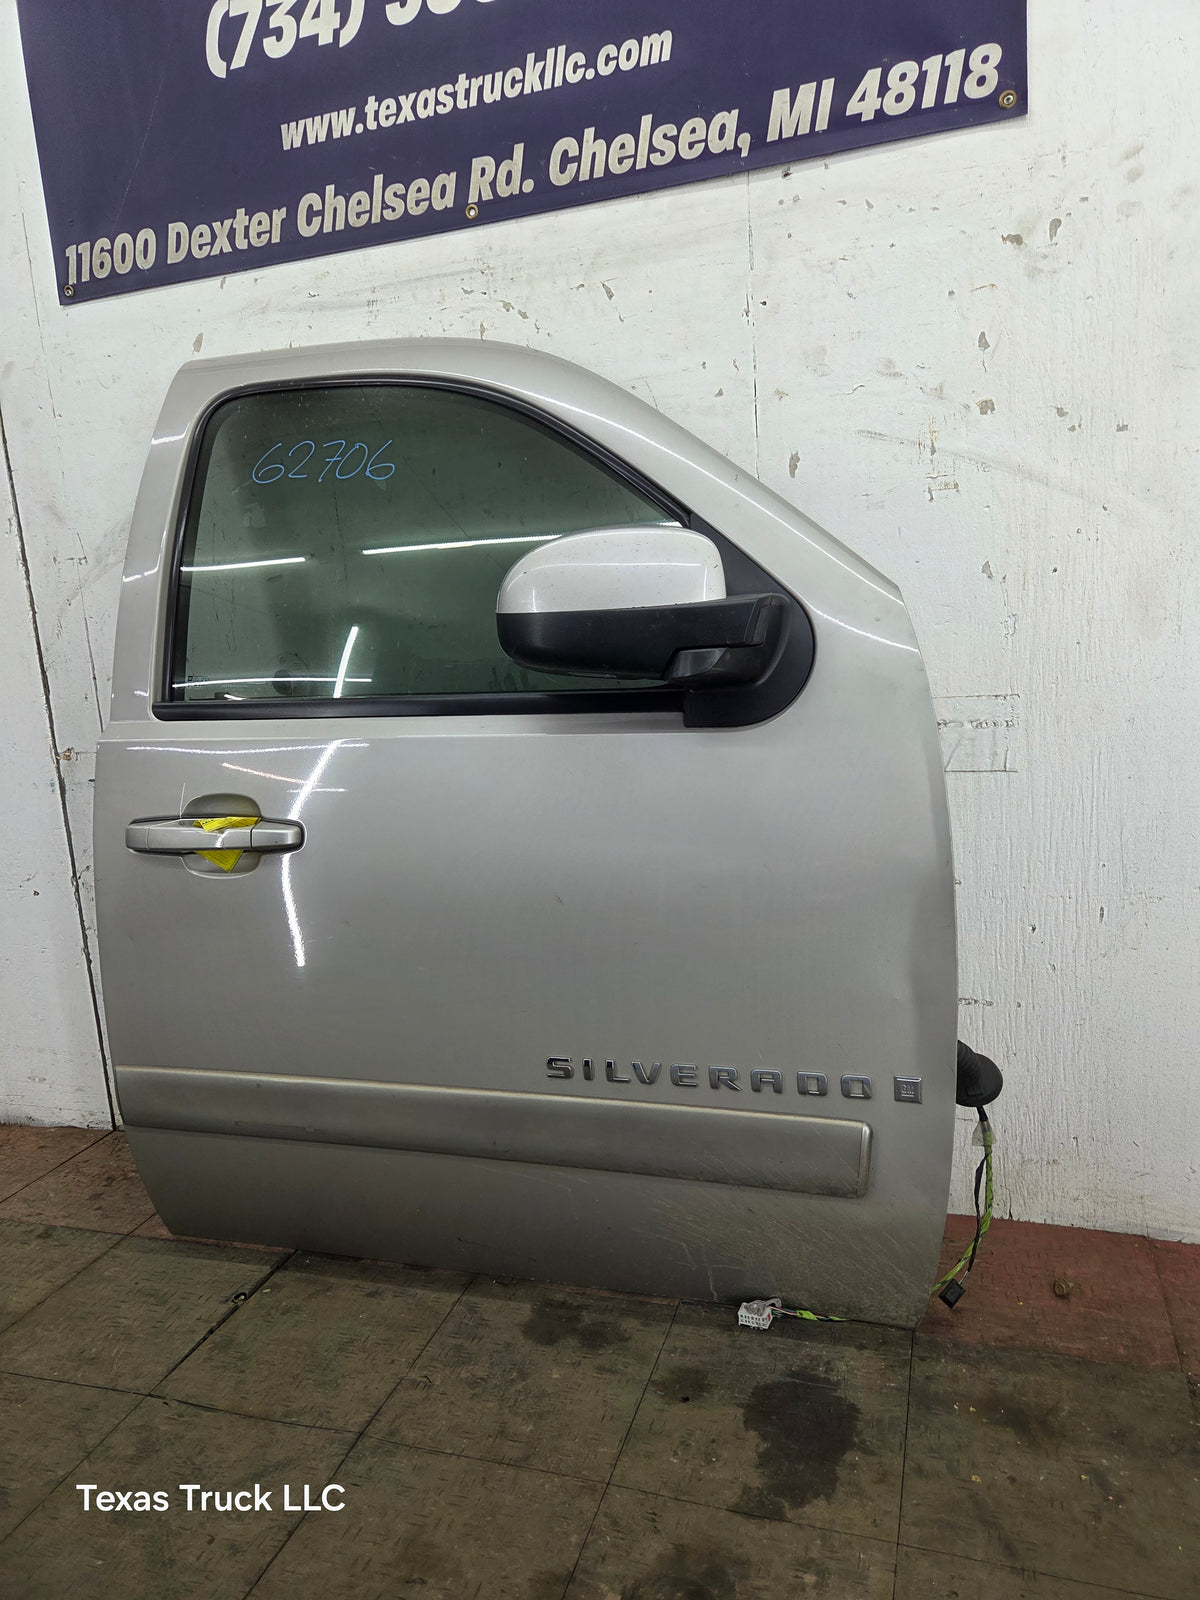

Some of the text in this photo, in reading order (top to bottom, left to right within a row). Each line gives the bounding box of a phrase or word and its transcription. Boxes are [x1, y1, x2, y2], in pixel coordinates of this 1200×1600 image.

[280, 29, 673, 151] www.texastruckllc.com
[65, 42, 1003, 286] 11600 Dexter Chelsea Rd. Chelsea, MI 48118
[252, 440, 396, 484] 62706
[546, 1055, 873, 1100] SILVERADO
